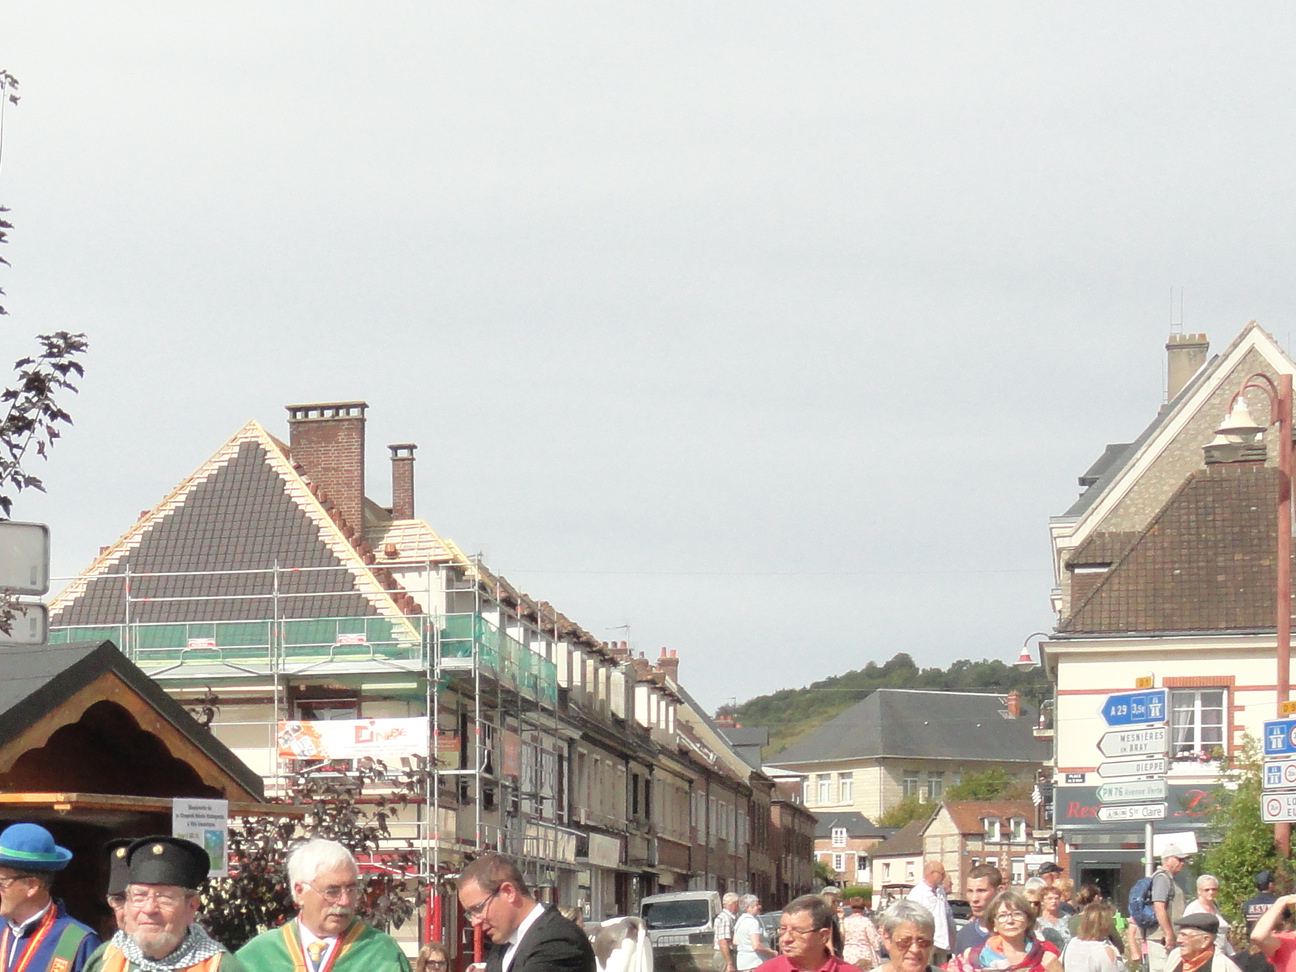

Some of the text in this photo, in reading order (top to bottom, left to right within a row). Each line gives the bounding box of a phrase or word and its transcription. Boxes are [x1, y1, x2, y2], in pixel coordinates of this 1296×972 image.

[1110, 705, 1128, 716] A 29
[1120, 731, 1164, 743] MESNIÈRES
[1129, 743, 1148, 752] BRAY
[1136, 762, 1163, 772] DIEPPE
[1103, 787, 1113, 797] PN
[1114, 786, 1123, 796] 76
